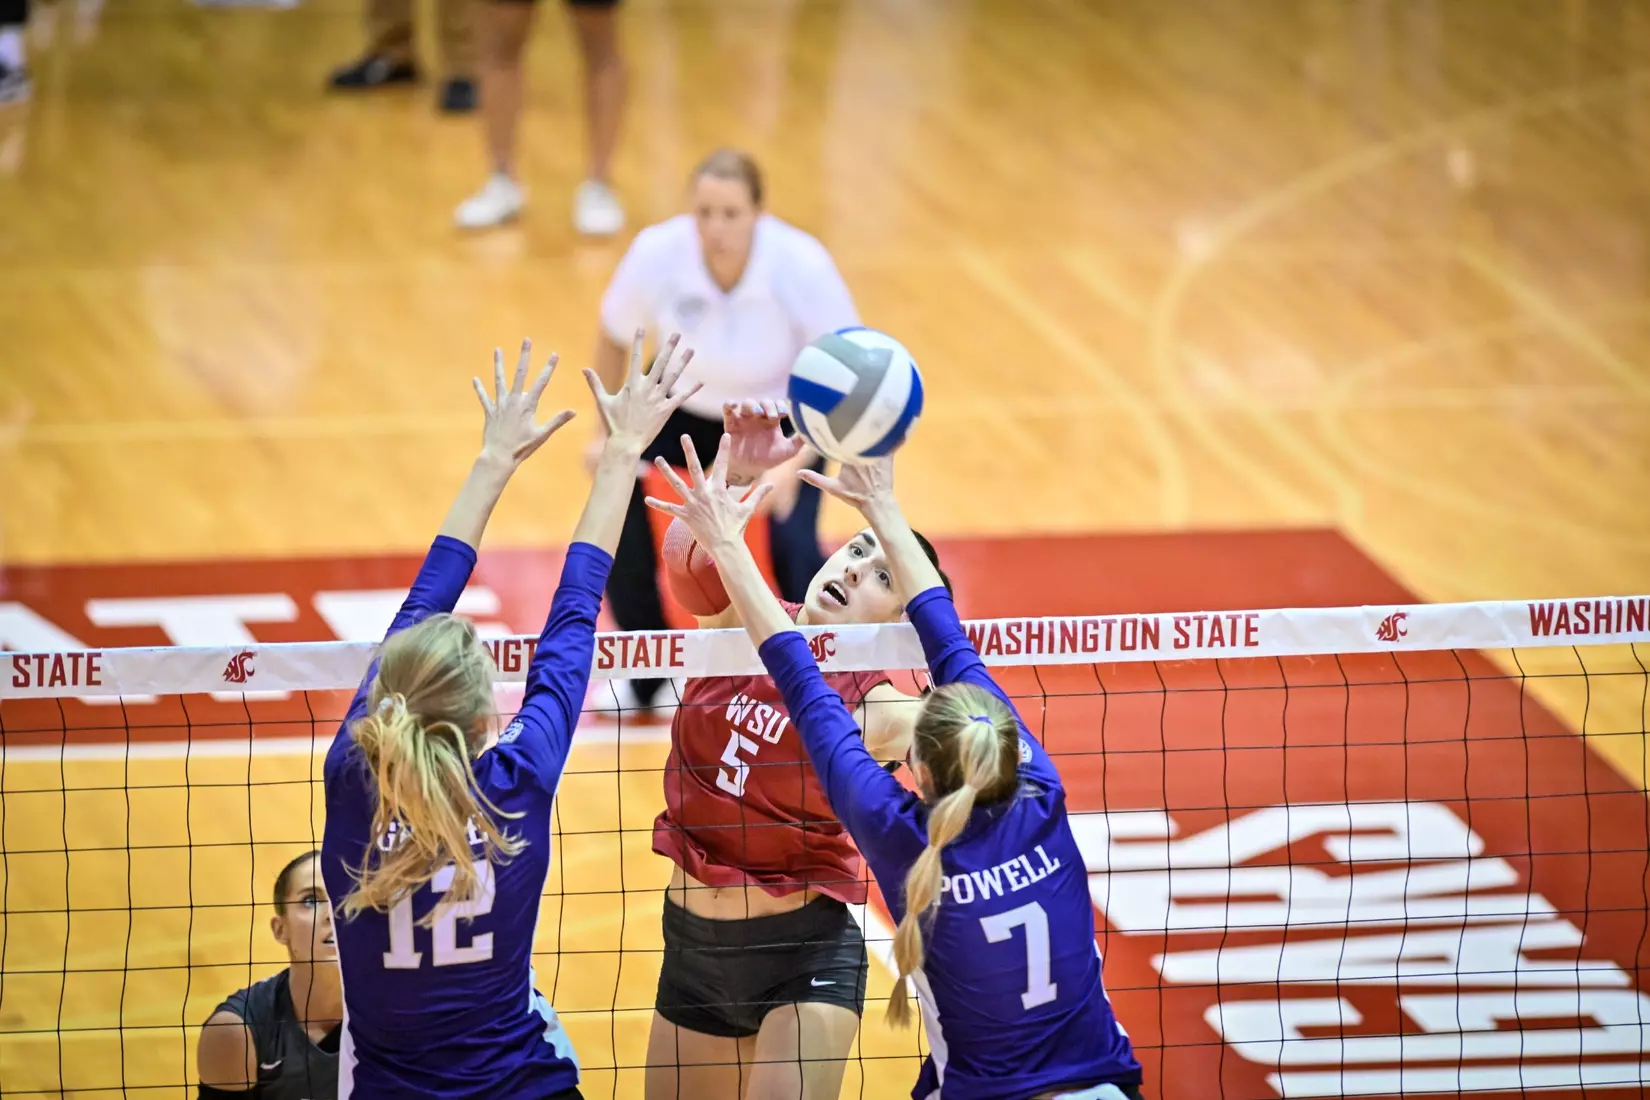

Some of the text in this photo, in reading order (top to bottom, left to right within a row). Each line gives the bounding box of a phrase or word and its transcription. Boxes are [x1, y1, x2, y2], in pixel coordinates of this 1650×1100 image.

[961, 613, 1260, 656] WASHINGTON STATE
[1528, 598, 1650, 637] WASHIN
[12, 652, 102, 688] STATE
[597, 633, 686, 670] STATE
[725, 692, 790, 745] WSU
[715, 728, 760, 798] 5
[932, 844, 1060, 906] POWELL
[382, 858, 496, 969] 12
[979, 900, 1058, 1011] 7
